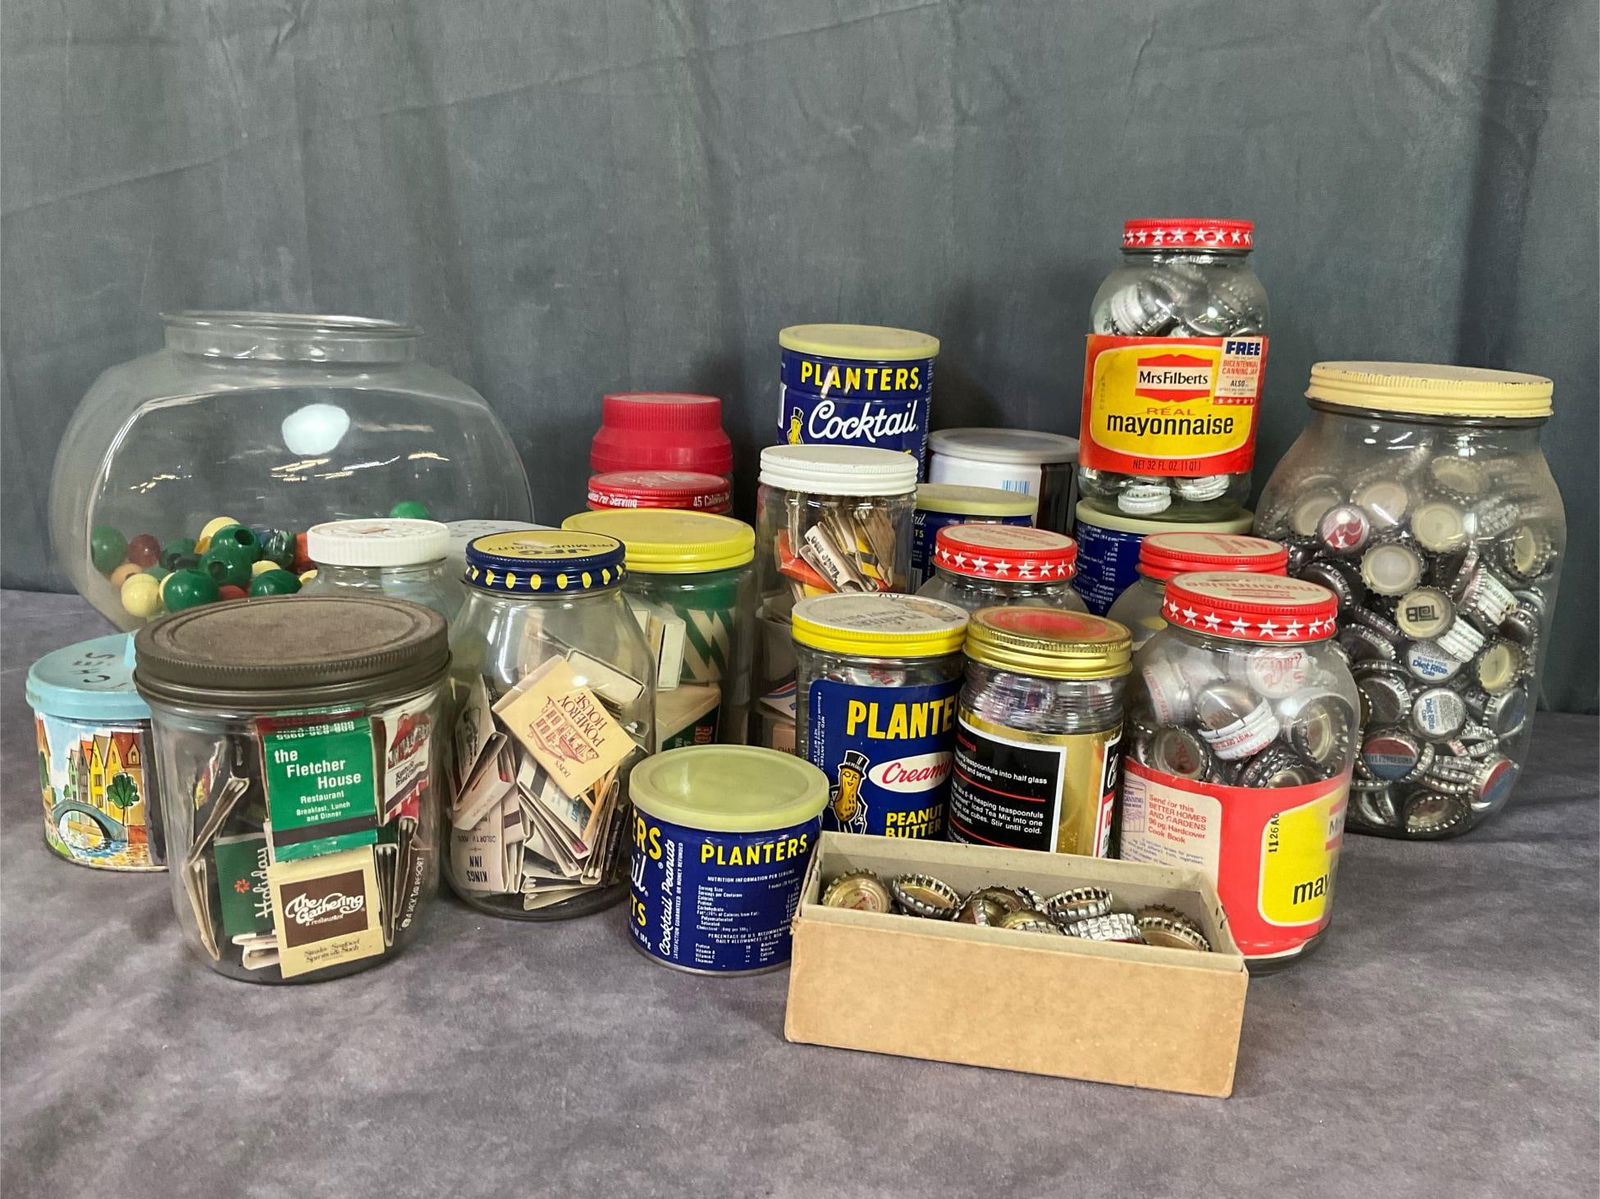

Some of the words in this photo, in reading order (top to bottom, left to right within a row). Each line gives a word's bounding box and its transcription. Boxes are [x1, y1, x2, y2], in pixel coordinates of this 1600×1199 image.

[1225, 341, 1260, 355] FREE
[801, 361, 919, 396] PLANTERS
[1146, 408, 1196, 416] REAL
[808, 400, 918, 444] Cocktail
[1107, 414, 1234, 437] mayonnaise
[1133, 459, 1145, 469] NET
[1147, 460, 1156, 469] 32
[610, 493, 638, 508] Serving
[693, 496, 703, 507] 45
[1412, 660, 1429, 670] Diet
[574, 692, 608, 730] HOUSE
[558, 696, 606, 747] POMEROY
[274, 749, 298, 764] the
[286, 758, 346, 778] Fletcher
[976, 771, 993, 782] serve.
[999, 770, 1013, 779] into
[1014, 773, 1027, 783] half
[1028, 776, 1048, 785] glass
[318, 773, 362, 790] House
[300, 790, 345, 804] Restaurant
[331, 801, 351, 810] Lunch
[1149, 794, 1166, 805] Send
[1168, 801, 1178, 809] for
[1180, 804, 1194, 813] this
[320, 811, 342, 820] Dinner
[886, 804, 943, 826] PEANUT
[972, 803, 984, 813] Iced
[986, 808, 997, 818] Tea
[998, 813, 1011, 822] Mix
[1012, 816, 1027, 825] into
[974, 796, 997, 811] heaping
[998, 806, 1044, 819] teaspoonfuls
[1149, 802, 1175, 815] BETTER
[1176, 811, 1207, 823] HOMES
[886, 821, 942, 839] BUTTER
[970, 811, 989, 824] cubes.
[991, 818, 1003, 828] Stir
[1006, 822, 1021, 832] until
[1024, 826, 1042, 835] cold.
[1149, 810, 1165, 820] AND
[1166, 816, 1207, 831] GARDENS
[1148, 826, 1165, 837] Cook
[1168, 833, 1186, 844] Book
[1168, 825, 1206, 839] Hardcover
[700, 834, 808, 867] PLANTERS
[469, 856, 483, 868] INN
[662, 838, 676, 897] Peanuts
[466, 870, 488, 883] KINGS
[285, 893, 322, 918] The
[296, 892, 364, 925] Gathering
[674, 896, 682, 928] GUARANTEED
[659, 896, 675, 956] Cocktail
